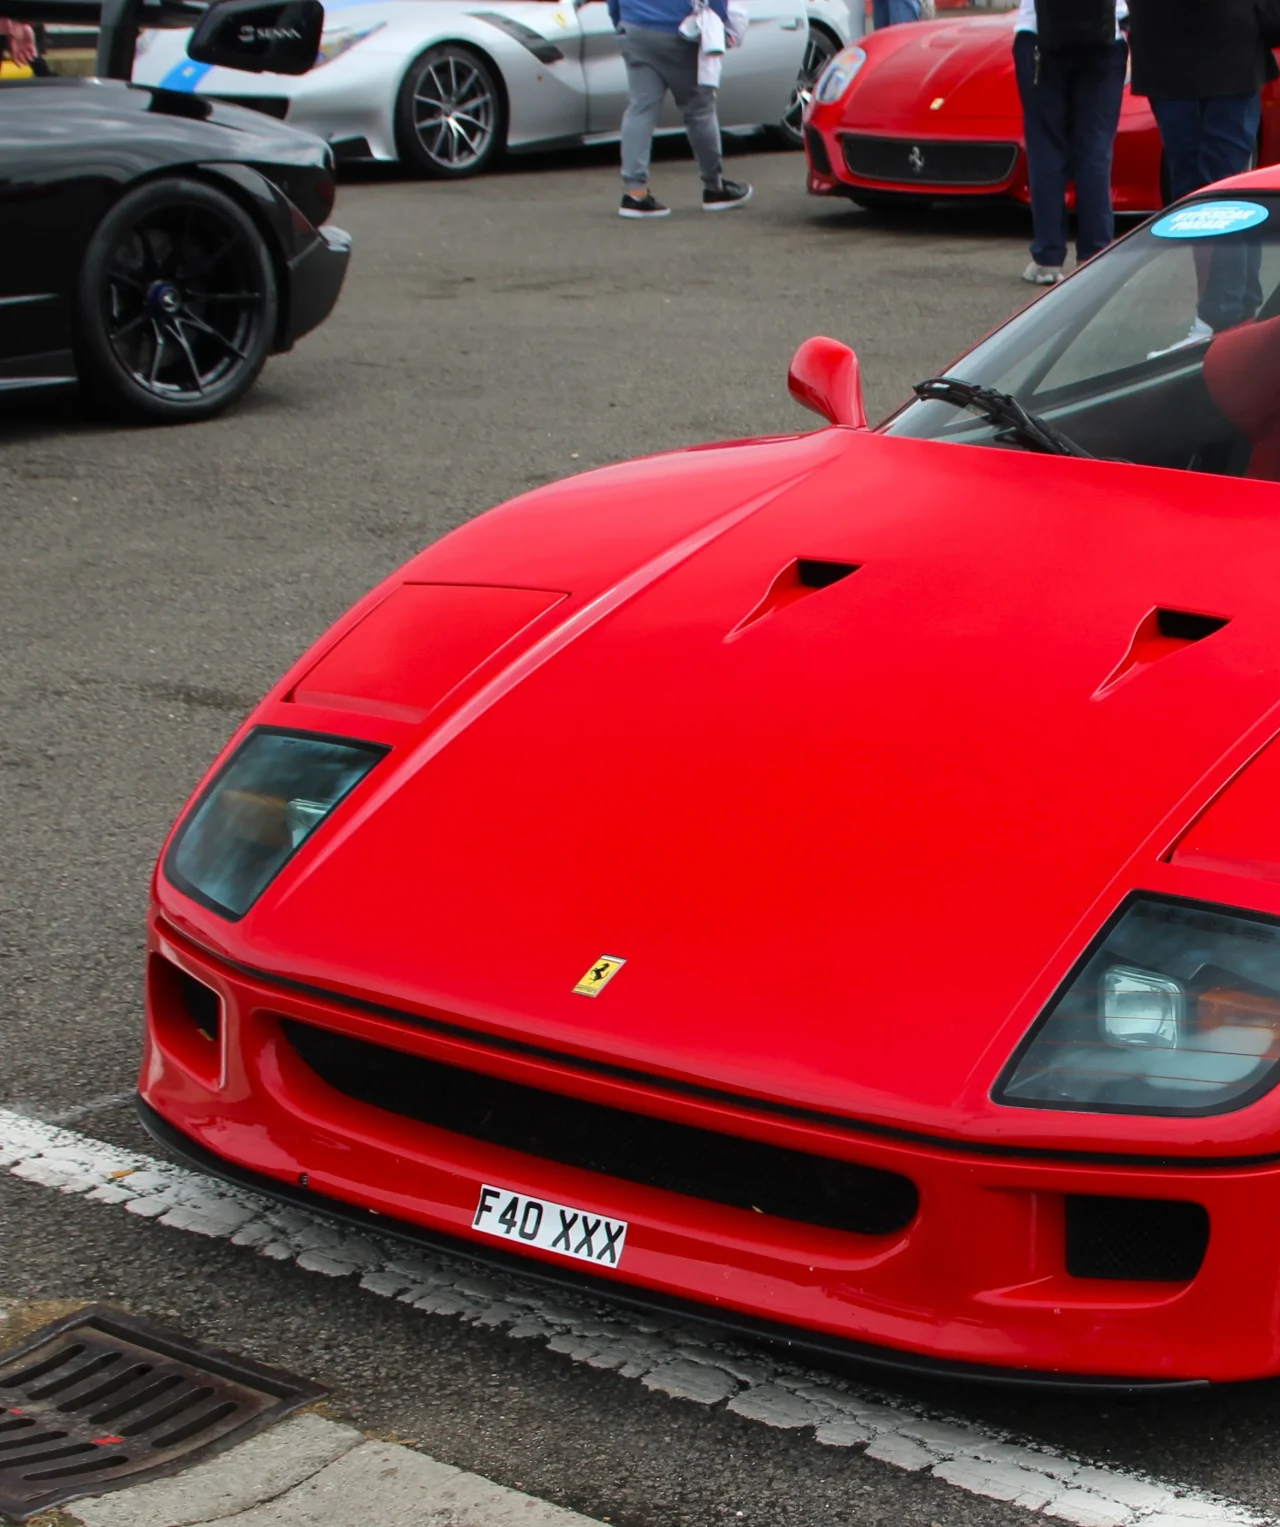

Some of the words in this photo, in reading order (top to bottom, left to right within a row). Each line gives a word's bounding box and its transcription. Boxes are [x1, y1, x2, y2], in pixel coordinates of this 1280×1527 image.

[257, 28, 302, 39] SENNA
[475, 1188, 543, 1241] F40
[552, 1210, 624, 1263] XXX
